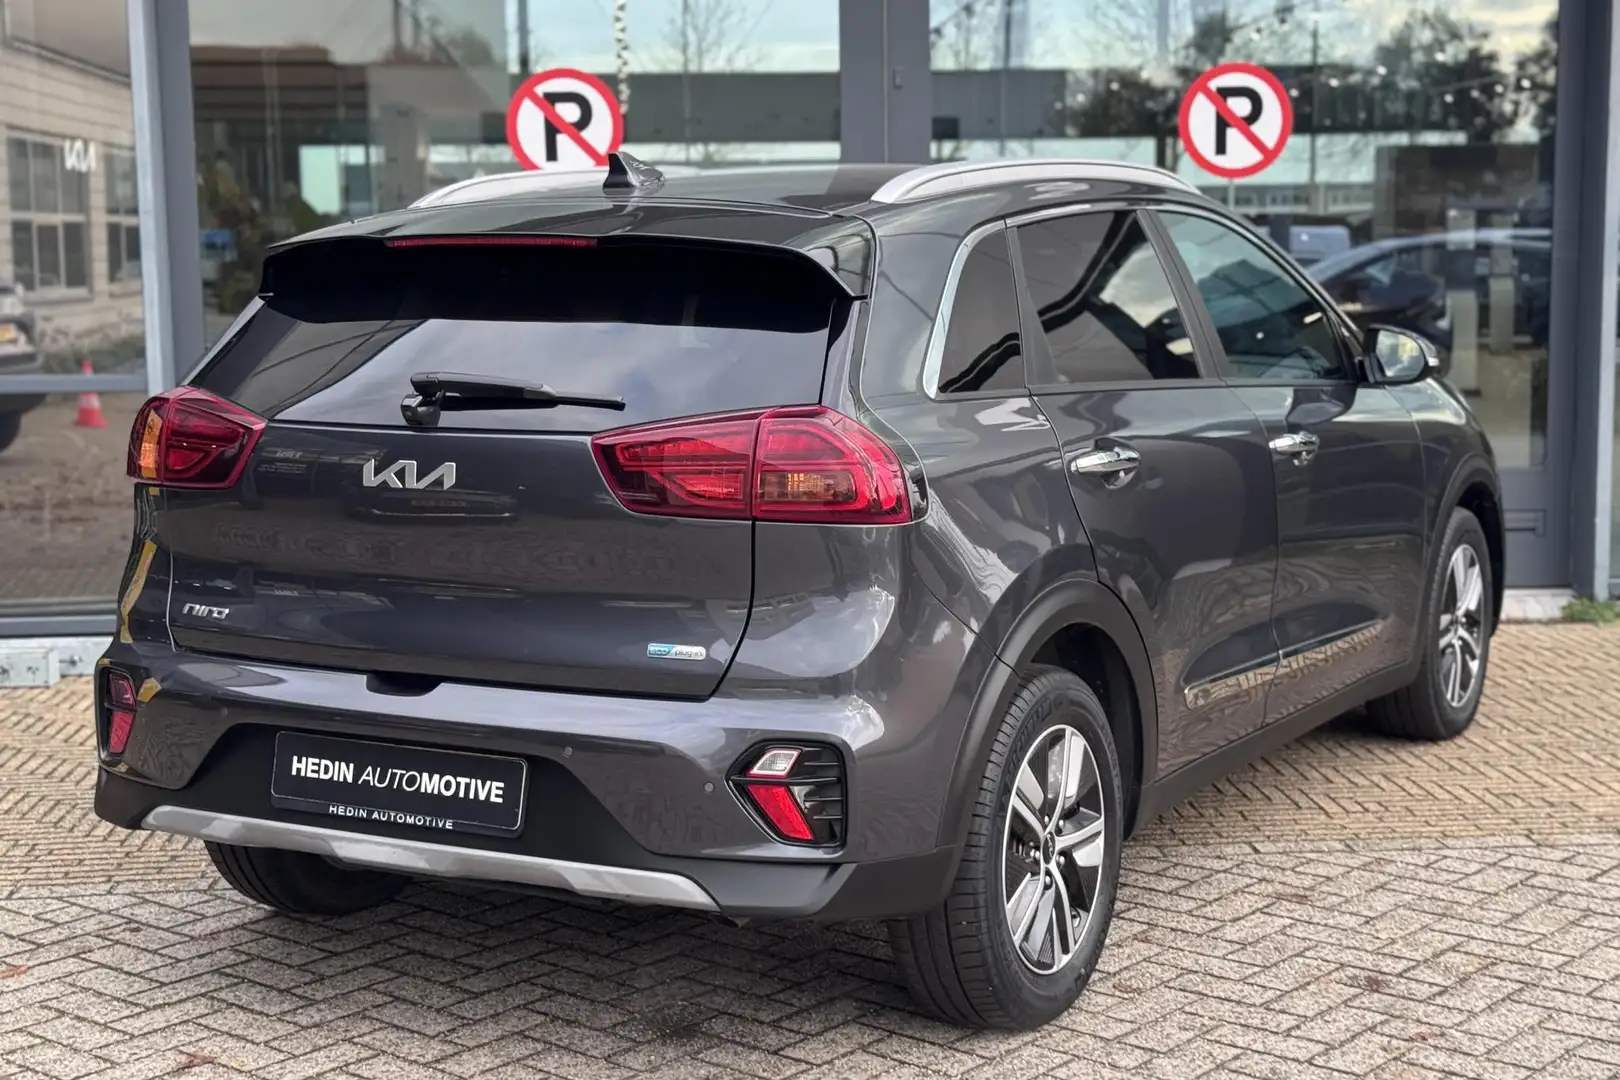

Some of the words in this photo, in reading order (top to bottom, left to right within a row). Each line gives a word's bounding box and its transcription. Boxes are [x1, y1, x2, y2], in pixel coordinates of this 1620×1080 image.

[363, 458, 456, 490] KIA
[291, 756, 354, 783] HEDIN
[358, 766, 505, 803] AUTOMOTIVE
[329, 805, 367, 818] HEDIN
[372, 811, 454, 829] AUTOMOTIVE
